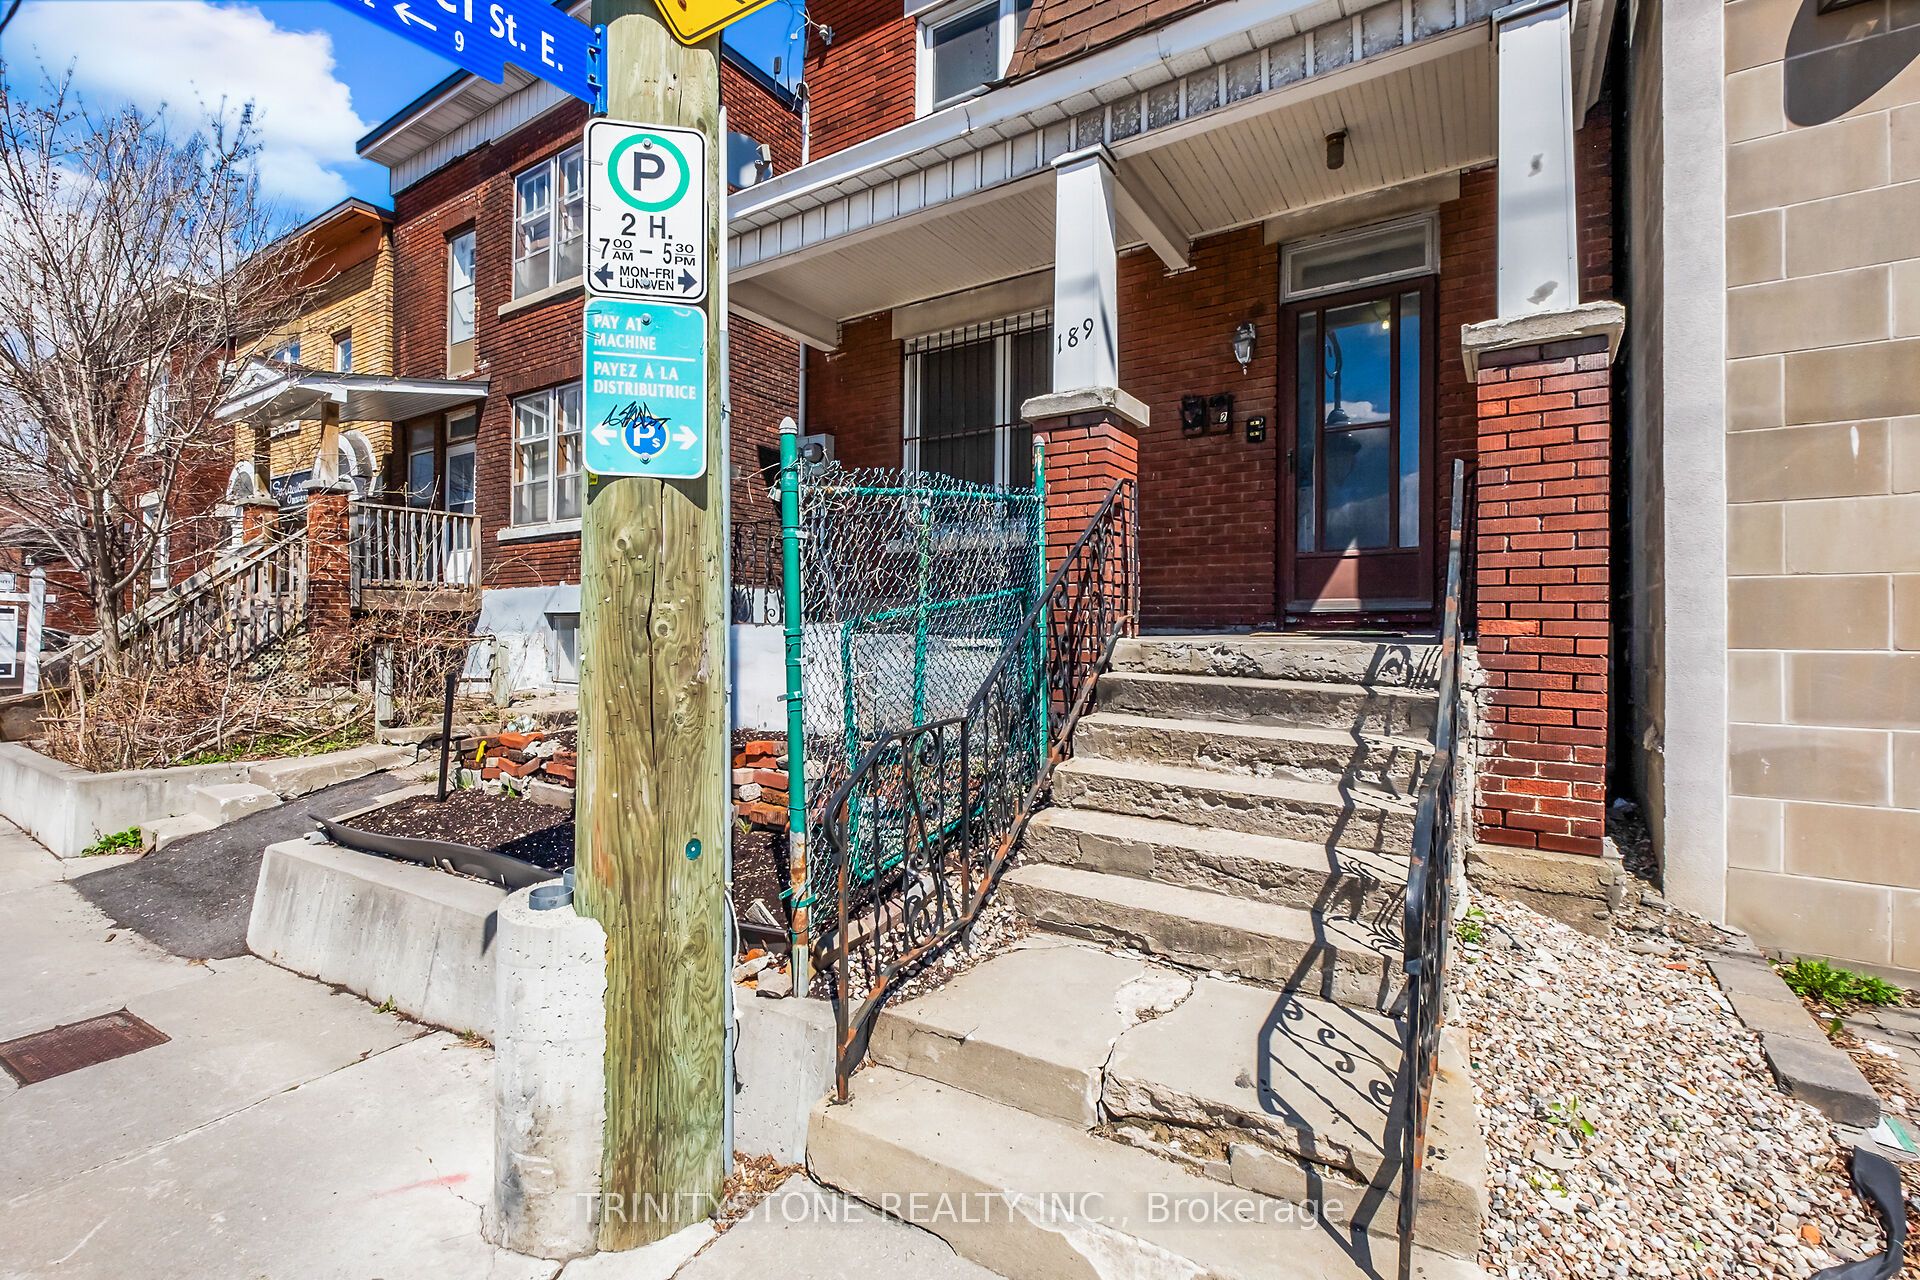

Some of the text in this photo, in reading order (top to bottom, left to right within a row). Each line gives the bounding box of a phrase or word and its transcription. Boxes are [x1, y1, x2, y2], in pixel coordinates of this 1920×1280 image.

[454, 31, 464, 52] 9
[489, 4, 526, 52] St.
[541, 30, 564, 72] E.
[633, 151, 665, 191] P
[621, 213, 673, 240] 2 H.
[612, 251, 696, 267] AM PM
[620, 266, 674, 279] MON-FRI
[619, 278, 674, 291] LUNVEN
[593, 314, 642, 331] PAY AT
[594, 333, 656, 350] MACHINE
[1057, 317, 1094, 355] 189
[593, 361, 679, 381] PAYEZ À LA
[594, 380, 696, 399] DISTRIBUTRICE
[1220, 411, 1228, 423] 2
